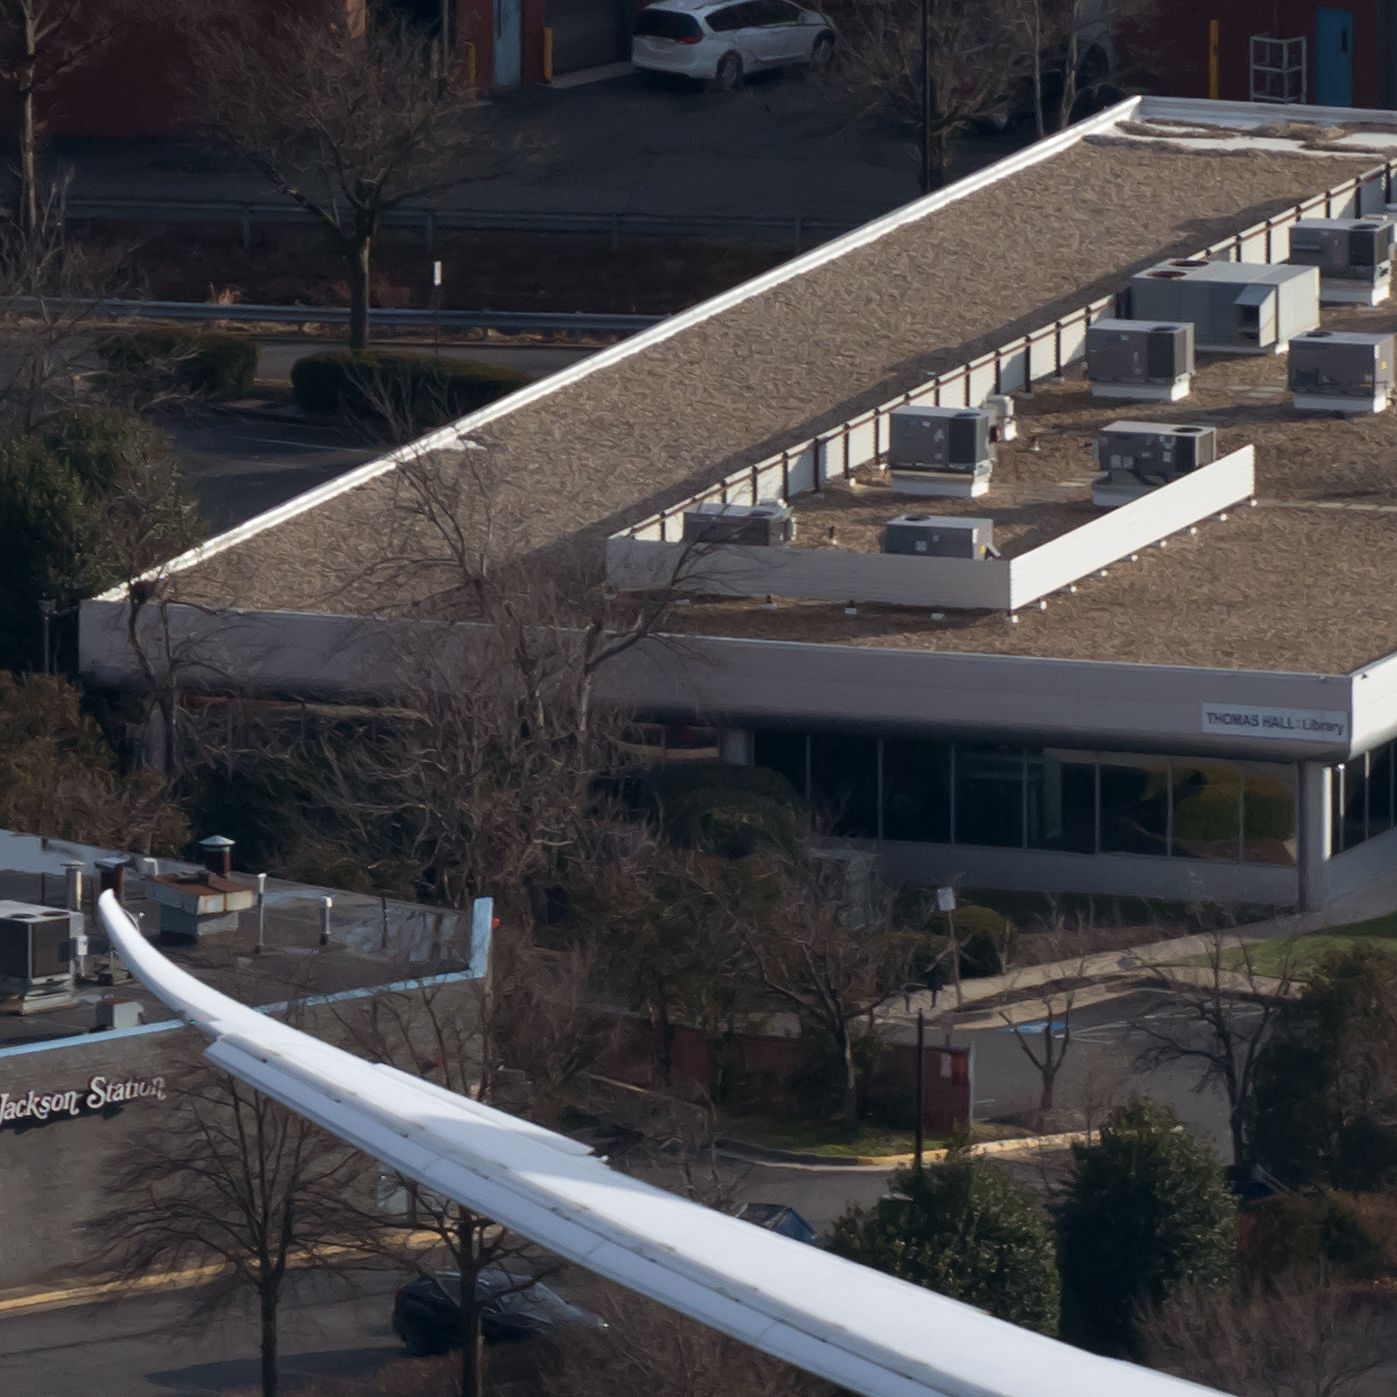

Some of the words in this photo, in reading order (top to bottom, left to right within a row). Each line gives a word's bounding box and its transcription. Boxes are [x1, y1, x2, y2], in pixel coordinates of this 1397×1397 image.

[1206, 711, 1259, 728] THOMAS
[1262, 714, 1295, 730] HALL
[0, 1090, 81, 1126] Jackson
[86, 1076, 168, 1109] Station
